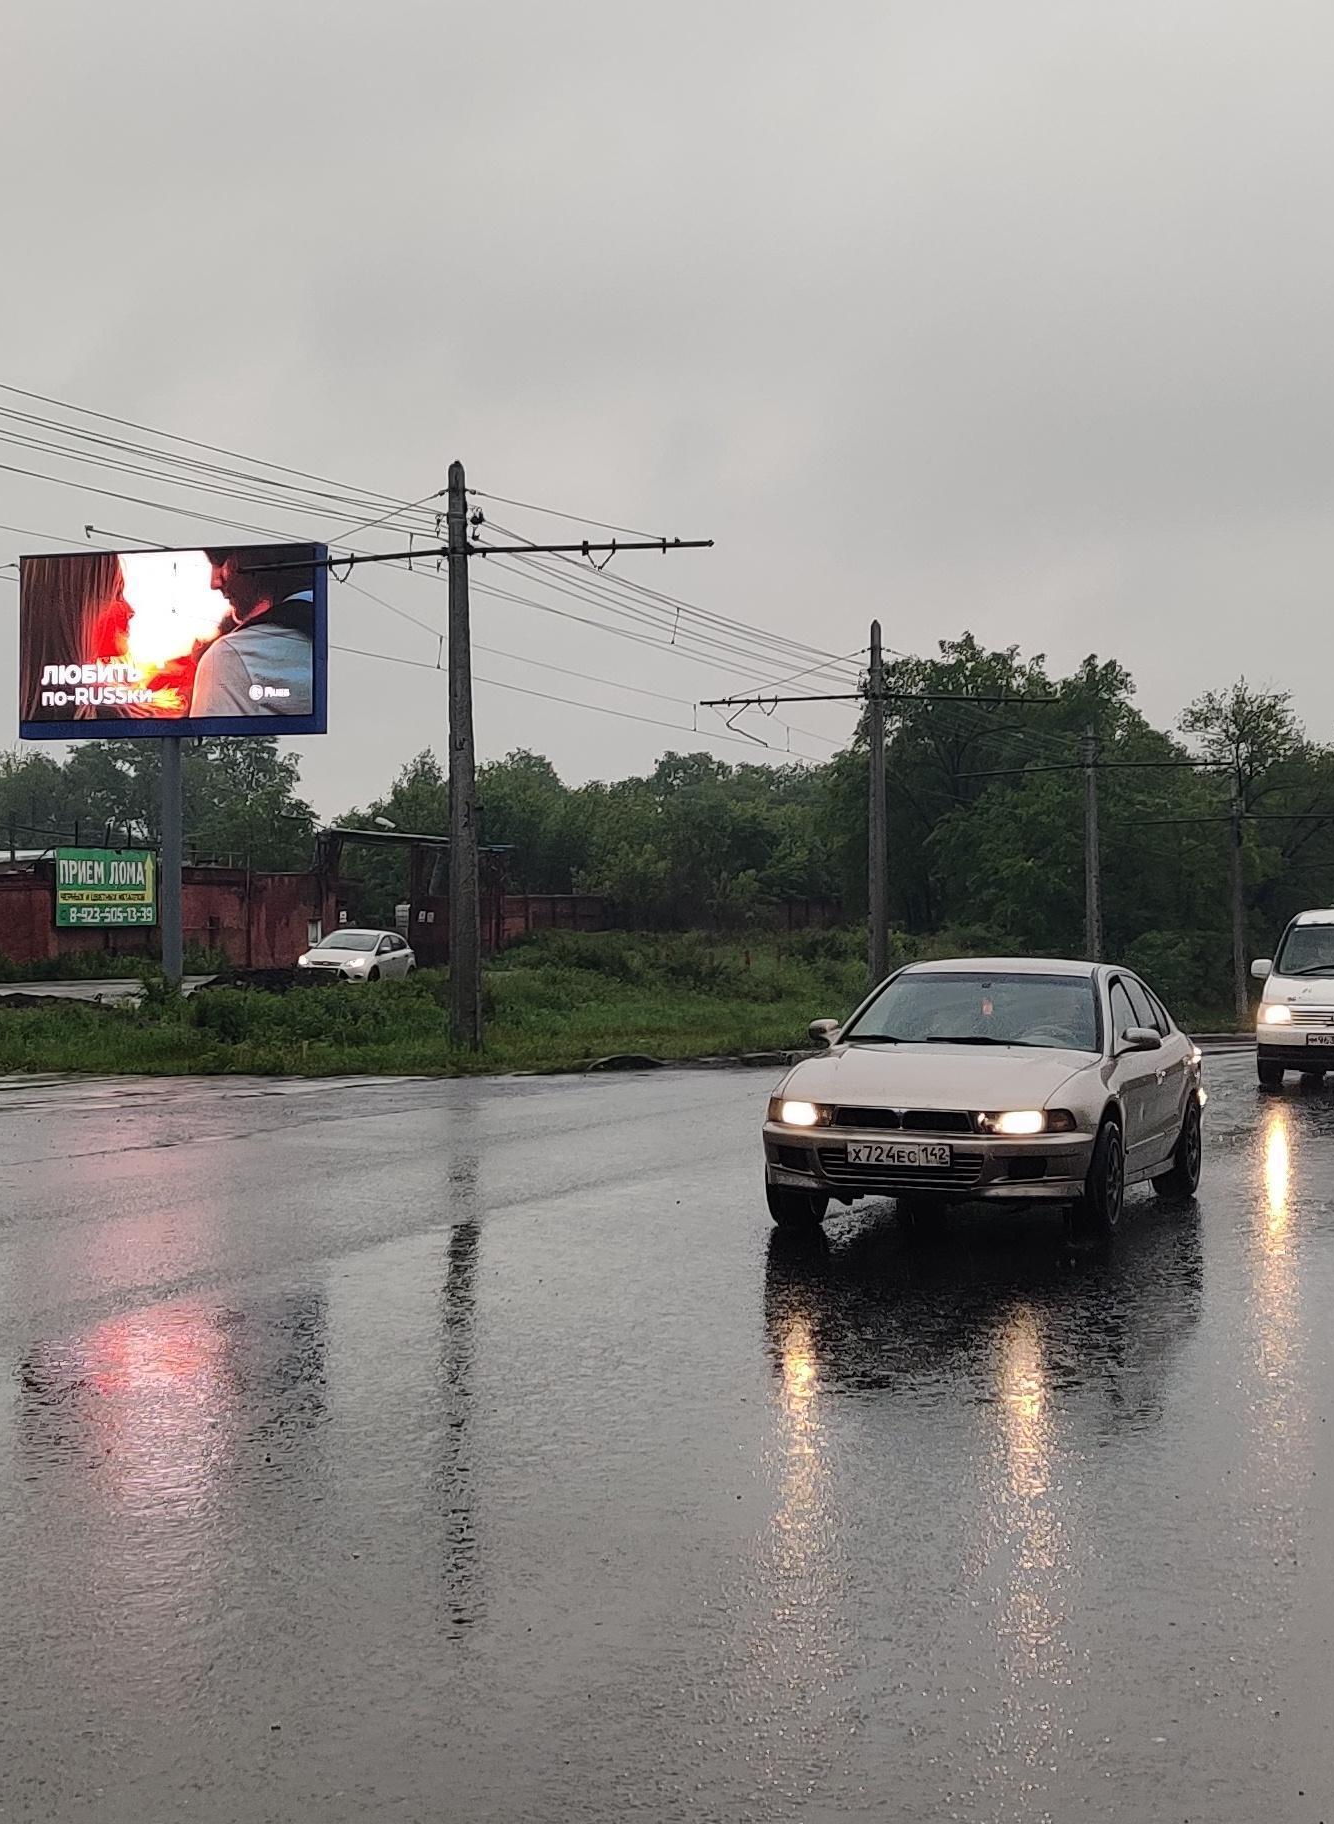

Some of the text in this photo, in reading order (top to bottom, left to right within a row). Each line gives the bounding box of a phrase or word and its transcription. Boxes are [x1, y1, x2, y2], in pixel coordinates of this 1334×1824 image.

[41, 664, 143, 686] ЛЮБИТЬ
[42, 687, 154, 706] по-RUSSки
[59, 859, 145, 886] ПРИЕМ ЛОМА
[852, 1145, 947, 1163] Х724ЕС 142
